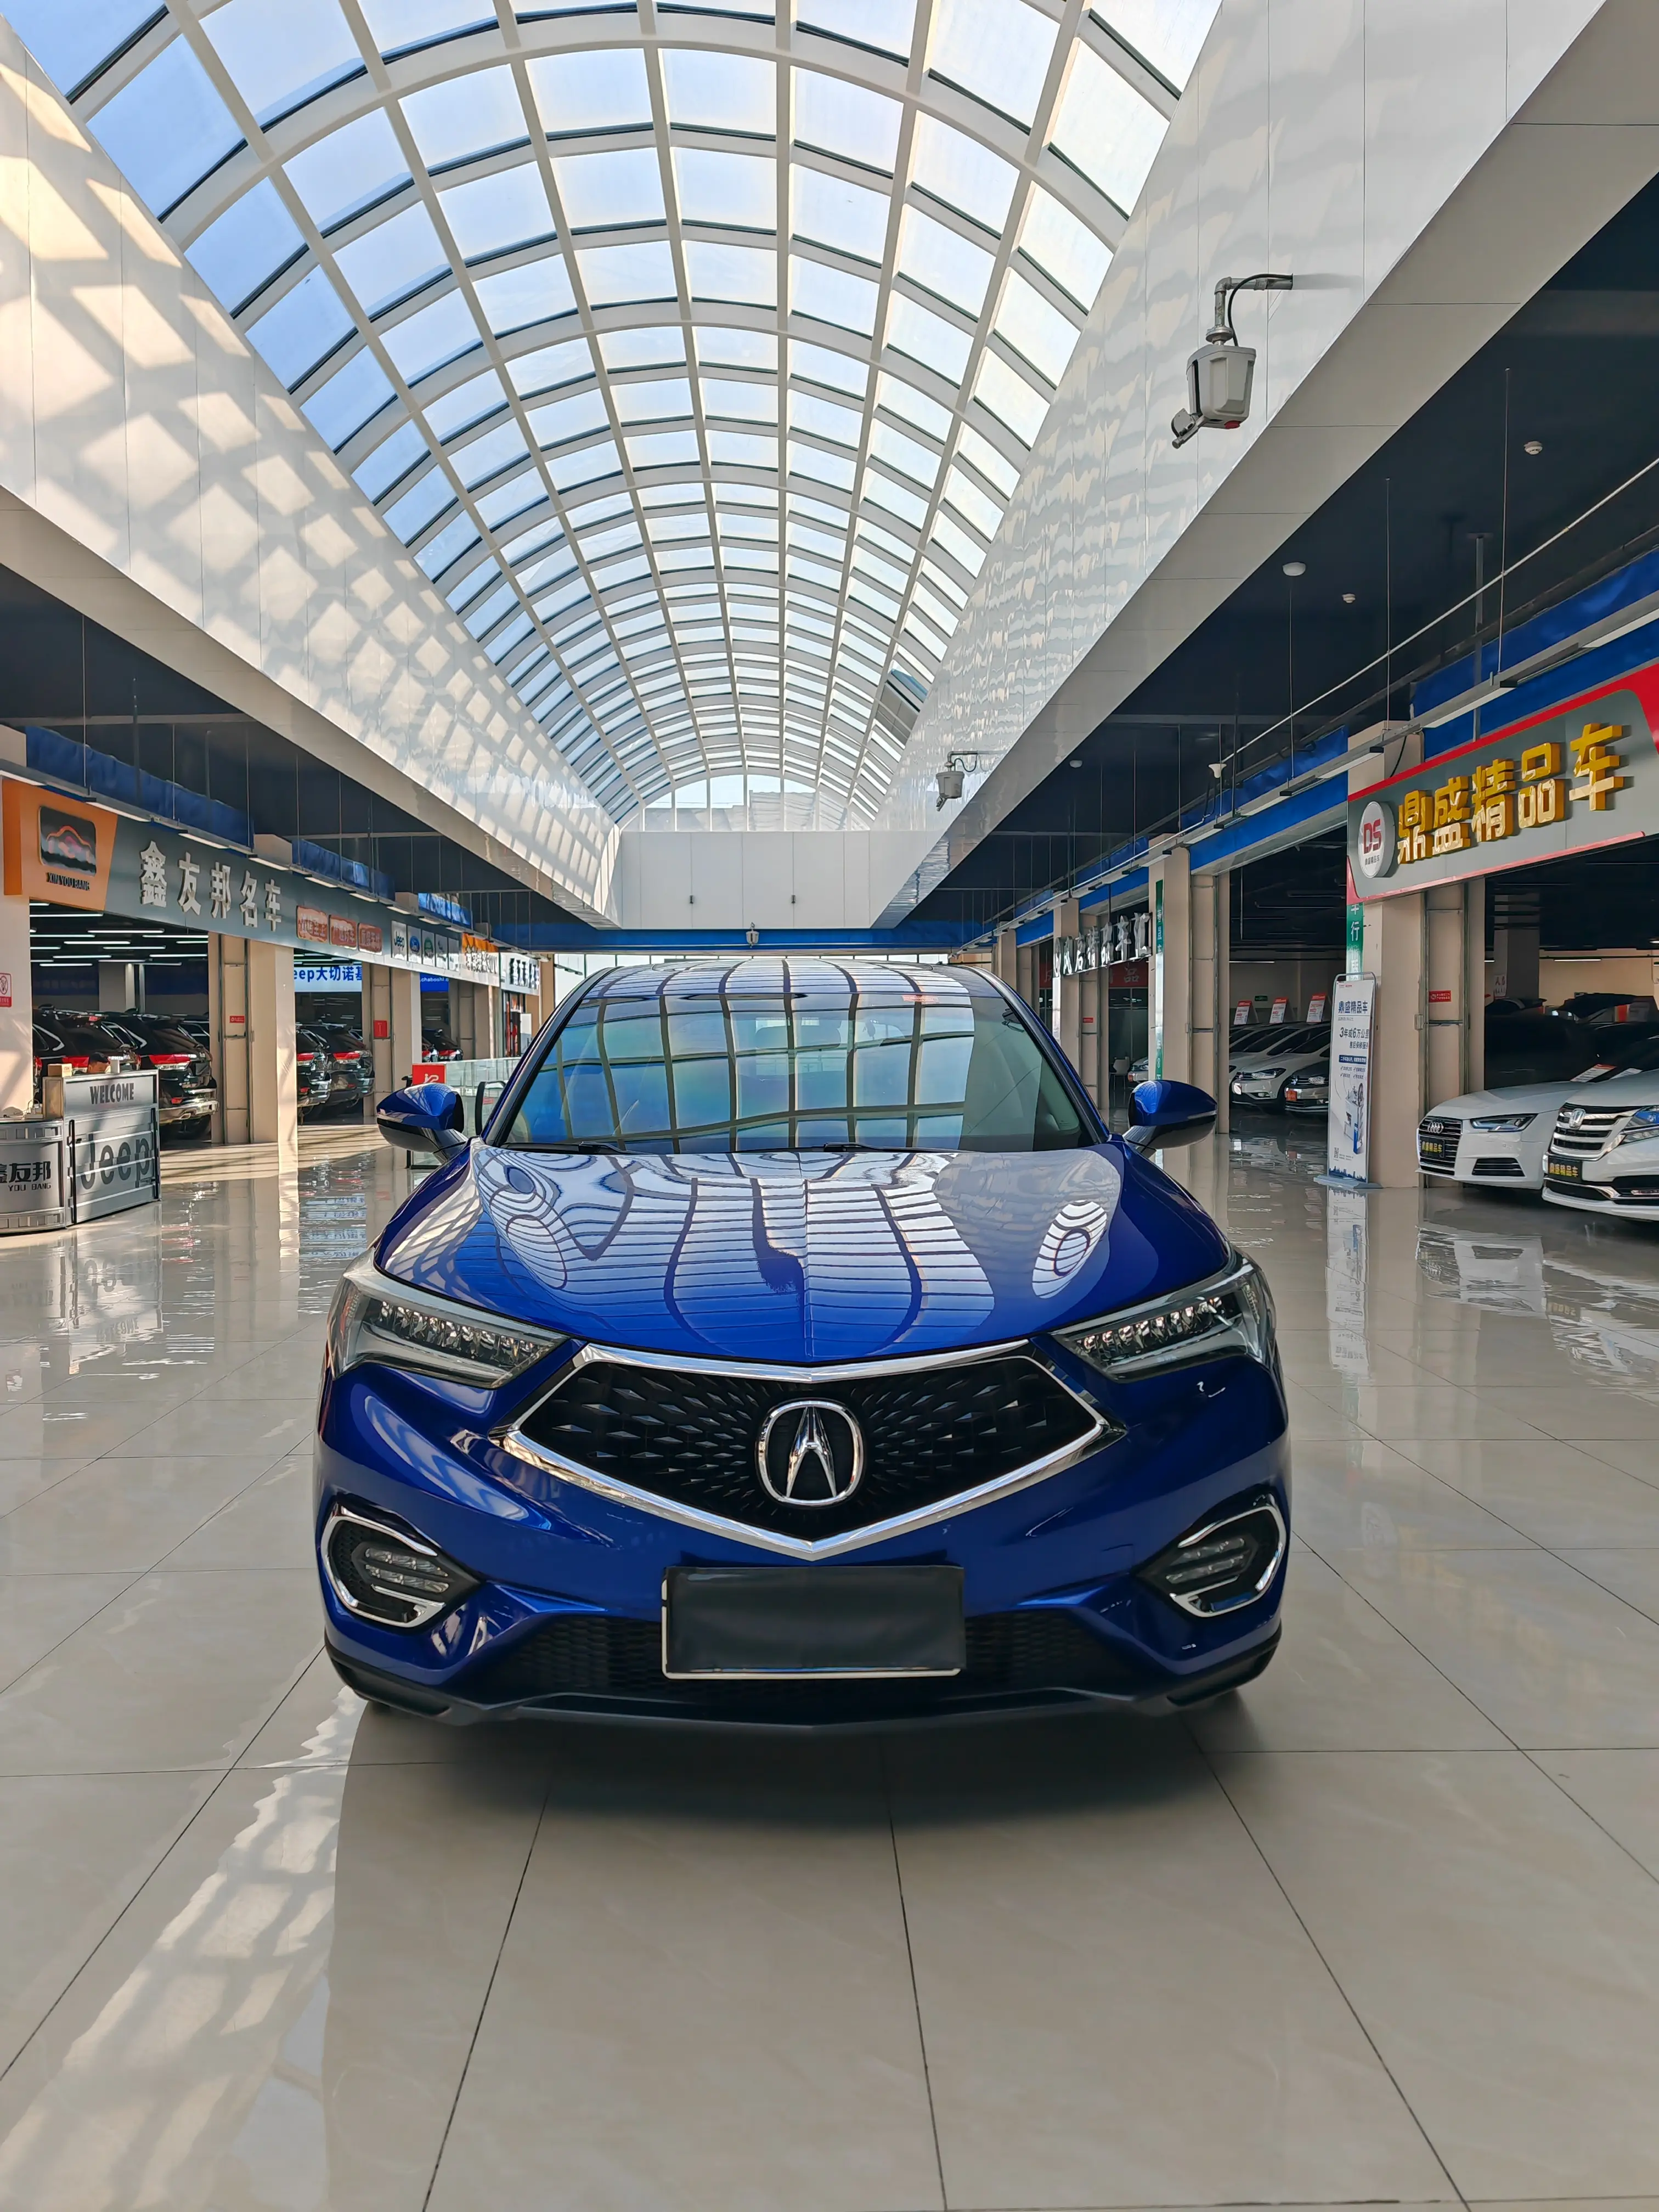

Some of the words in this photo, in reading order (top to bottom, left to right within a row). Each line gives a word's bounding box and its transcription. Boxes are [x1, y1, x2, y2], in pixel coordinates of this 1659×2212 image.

[1397, 723, 1623, 865] 鼎盛精品车
[1363, 818, 1382, 854] DS
[140, 840, 282, 932] 鑫友邦名车
[394, 930, 405, 951] Jeep
[1339, 1001, 1368, 1014] 鼎盛精品车
[89, 1082, 134, 1104] WELCOME
[80, 1133, 150, 1189] Jeep
